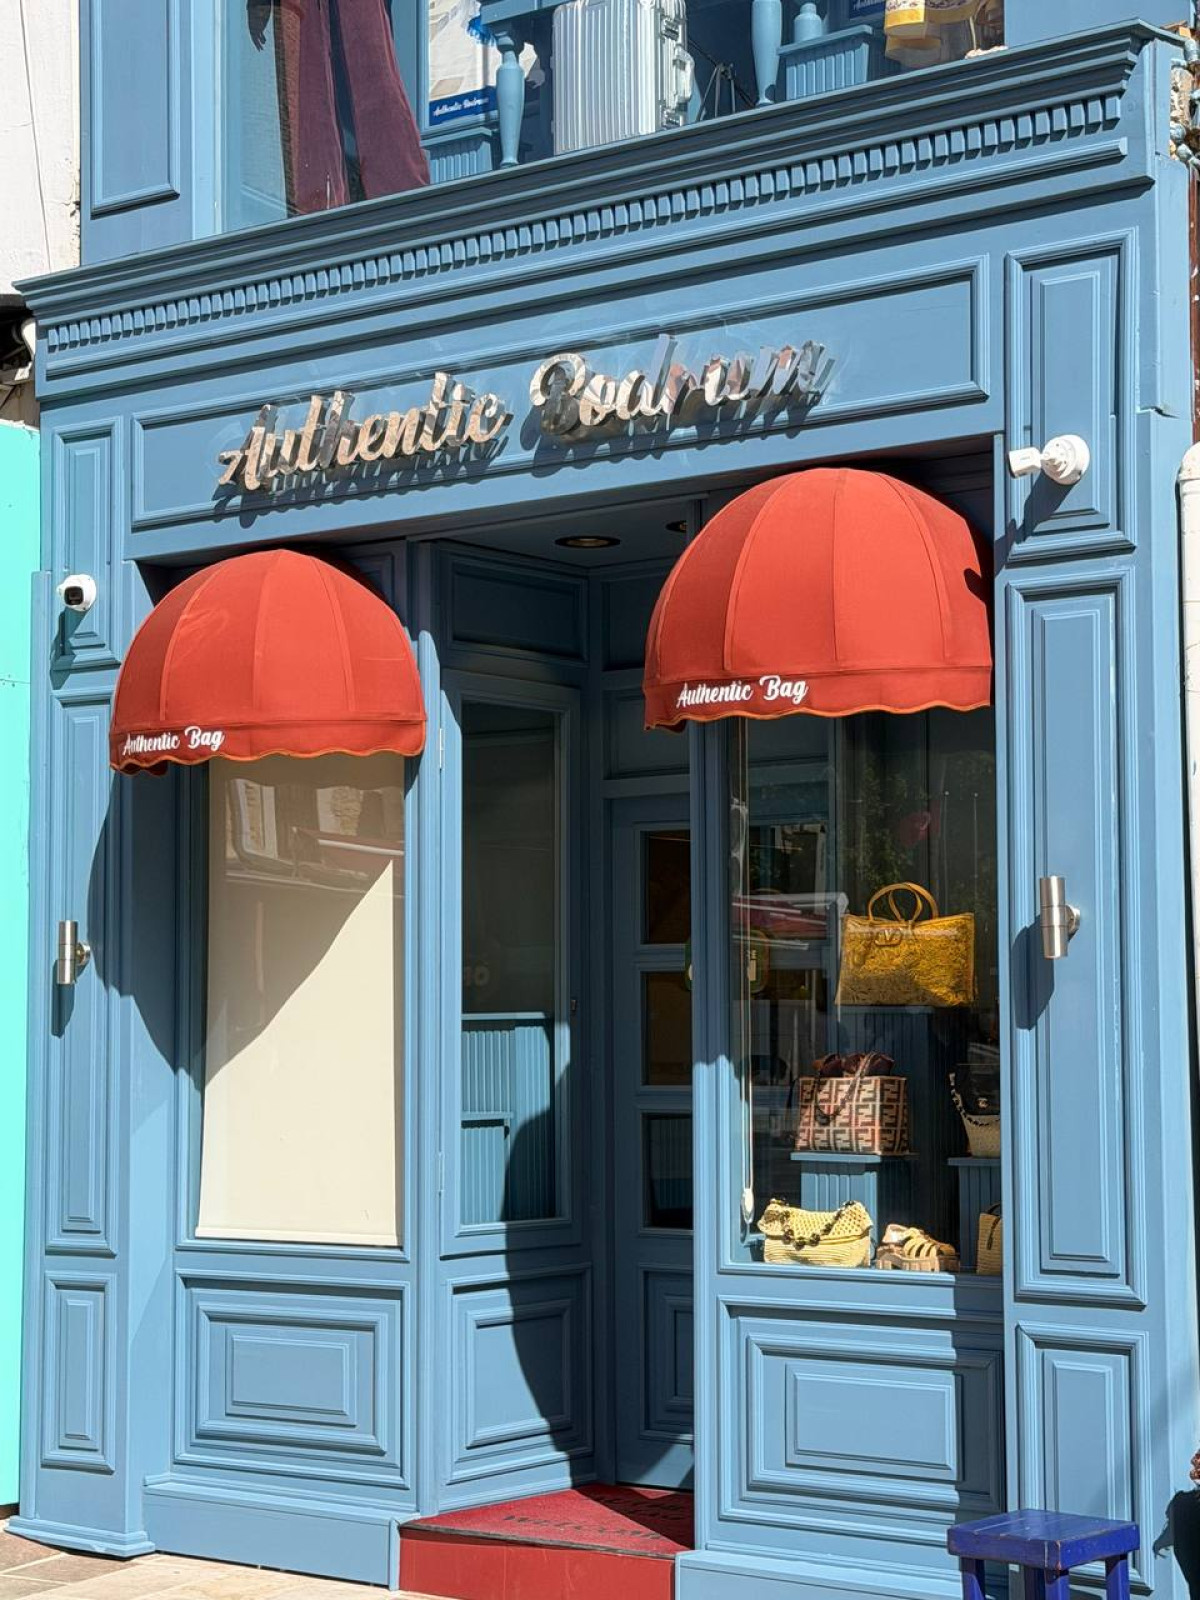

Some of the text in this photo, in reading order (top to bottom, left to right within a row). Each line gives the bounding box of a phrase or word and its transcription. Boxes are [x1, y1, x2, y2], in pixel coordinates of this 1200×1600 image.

[218, 333, 836, 491] Authentic Bodrum
[676, 675, 808, 708] Authentic Bag
[122, 725, 226, 756] Authentic Bag
